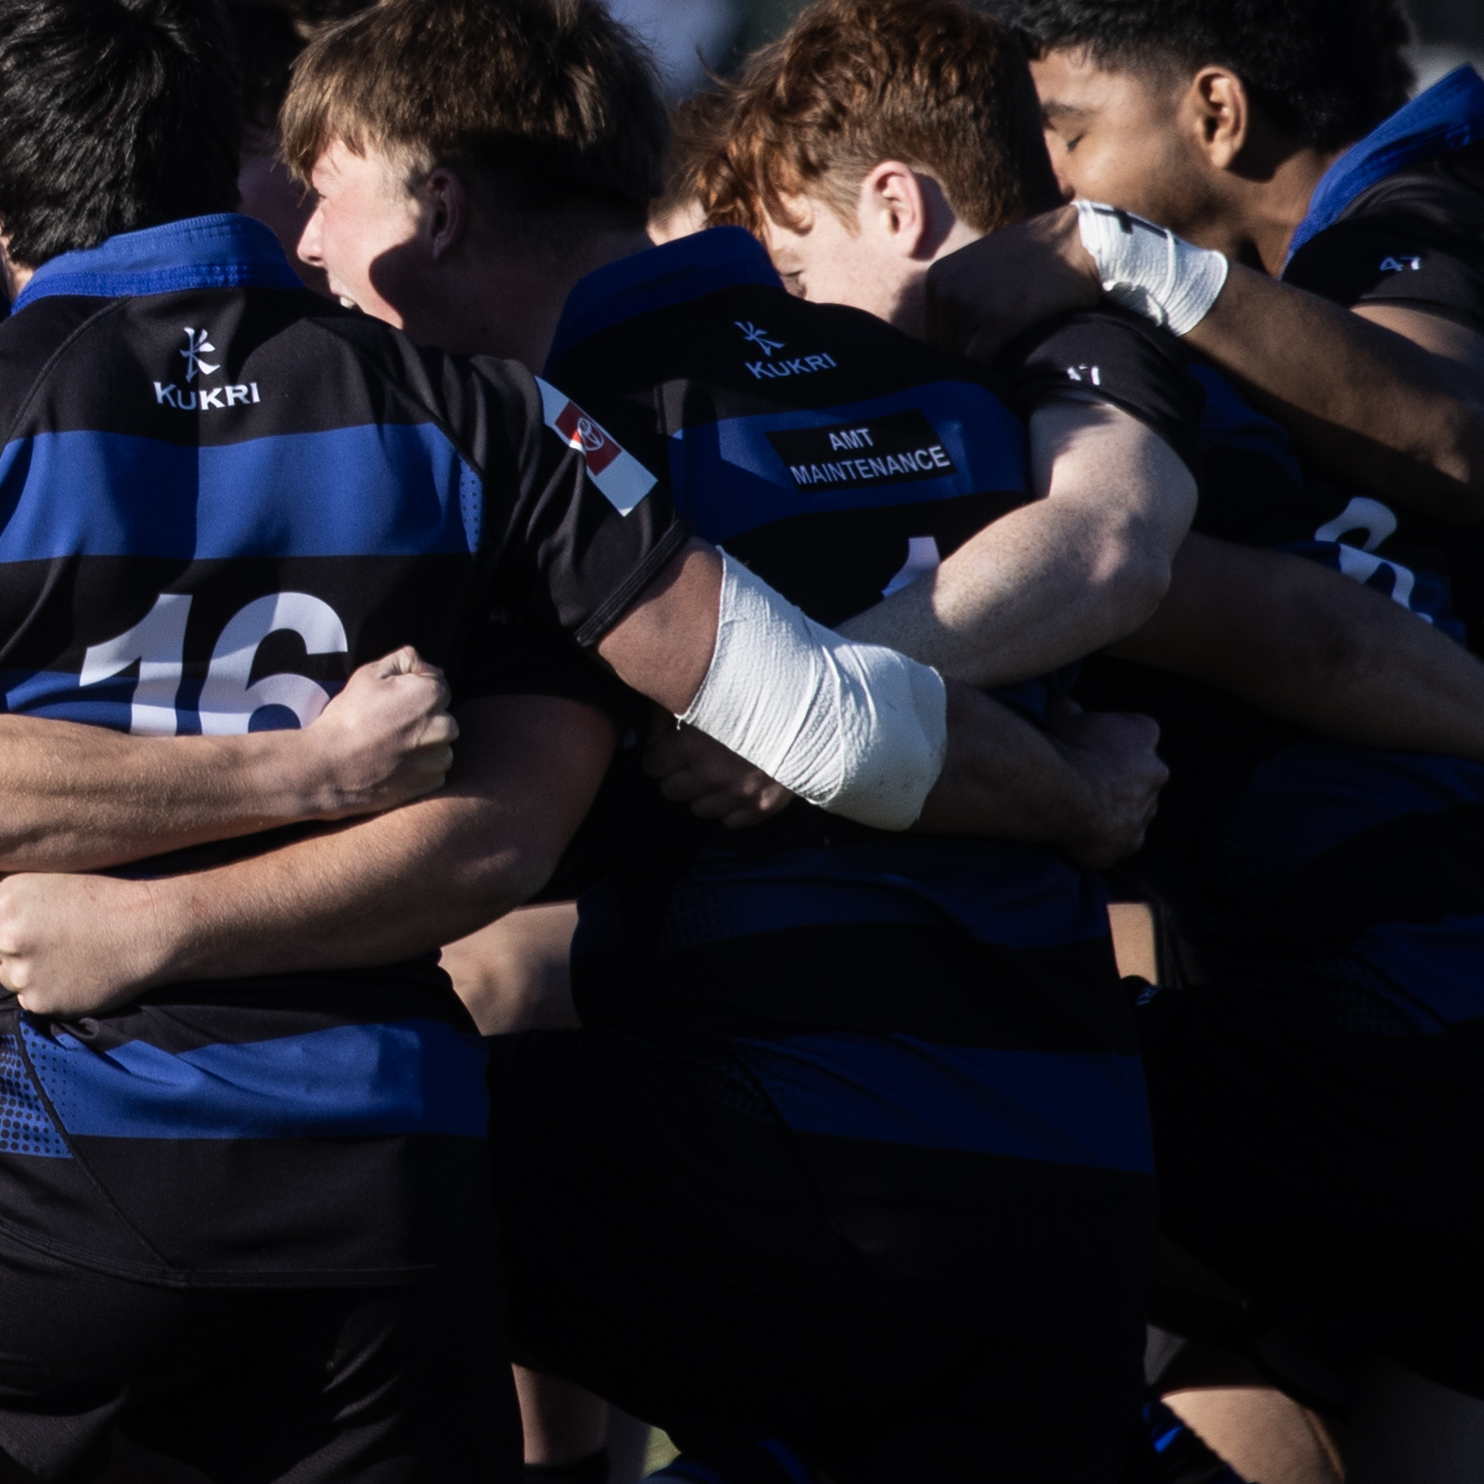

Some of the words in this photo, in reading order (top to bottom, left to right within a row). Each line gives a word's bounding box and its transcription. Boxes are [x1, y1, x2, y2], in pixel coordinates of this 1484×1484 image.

[745, 352, 837, 380] KUKRI
[153, 381, 261, 411] KUKRI
[829, 427, 875, 452] AMT
[789, 445, 951, 486] MAINTENANCE
[79, 591, 349, 737] 16
